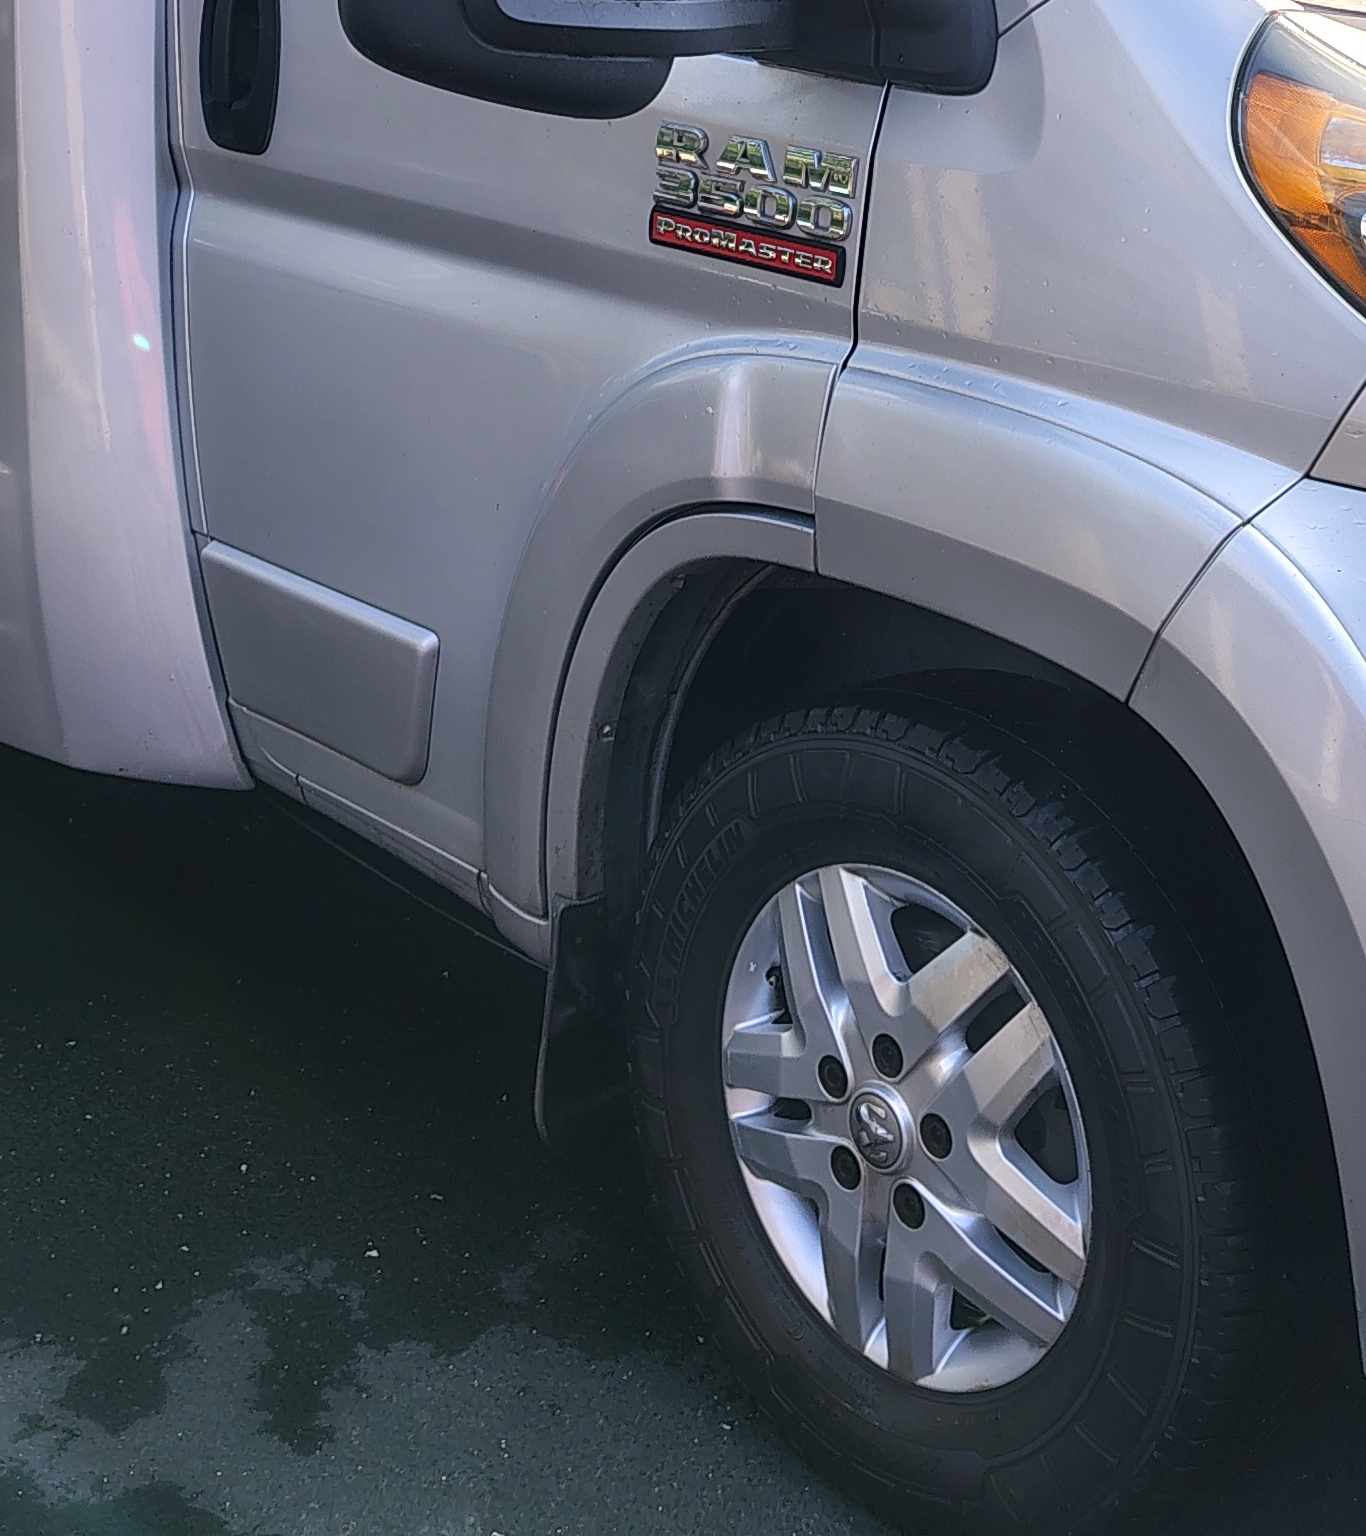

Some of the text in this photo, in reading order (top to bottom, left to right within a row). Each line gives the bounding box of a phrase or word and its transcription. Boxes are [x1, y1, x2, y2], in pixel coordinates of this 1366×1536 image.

[654, 119, 860, 200] RAM
[652, 164, 854, 242] 3500
[661, 819, 748, 971] MICHELIN
